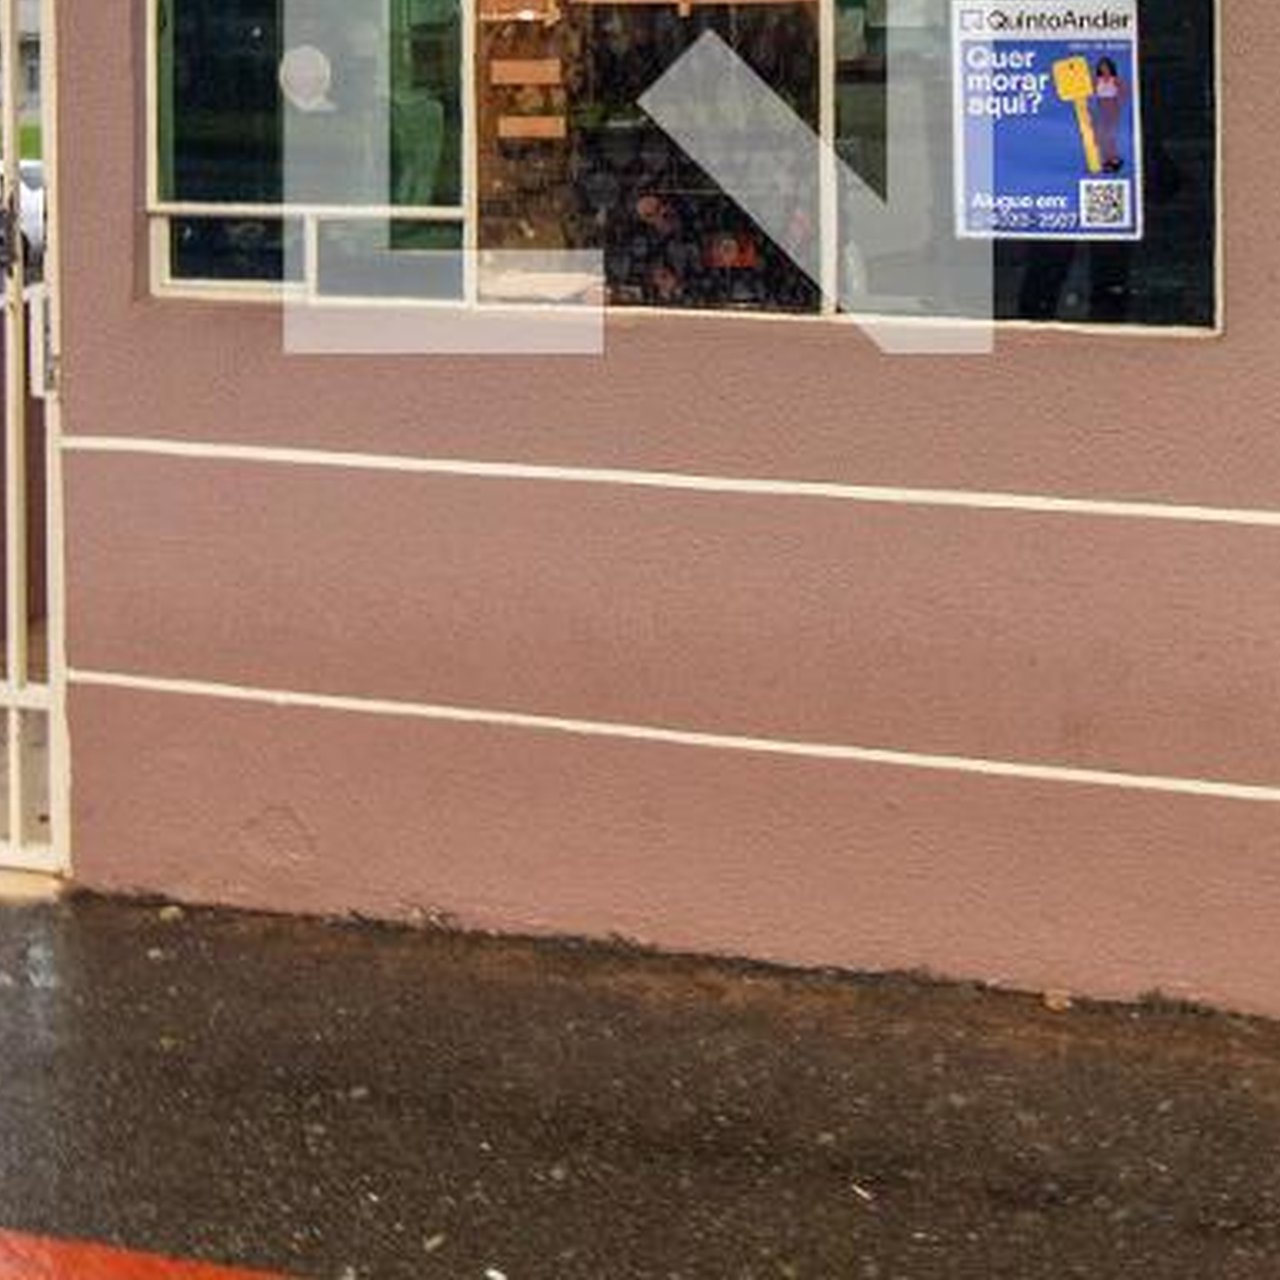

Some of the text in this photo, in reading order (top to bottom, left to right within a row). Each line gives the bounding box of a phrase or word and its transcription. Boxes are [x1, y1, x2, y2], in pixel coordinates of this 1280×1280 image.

[987, 9, 1130, 31] QuintoAndar
[966, 46, 1035, 69] Quer
[967, 73, 1050, 91] morar
[967, 92, 1043, 119] aqui?
